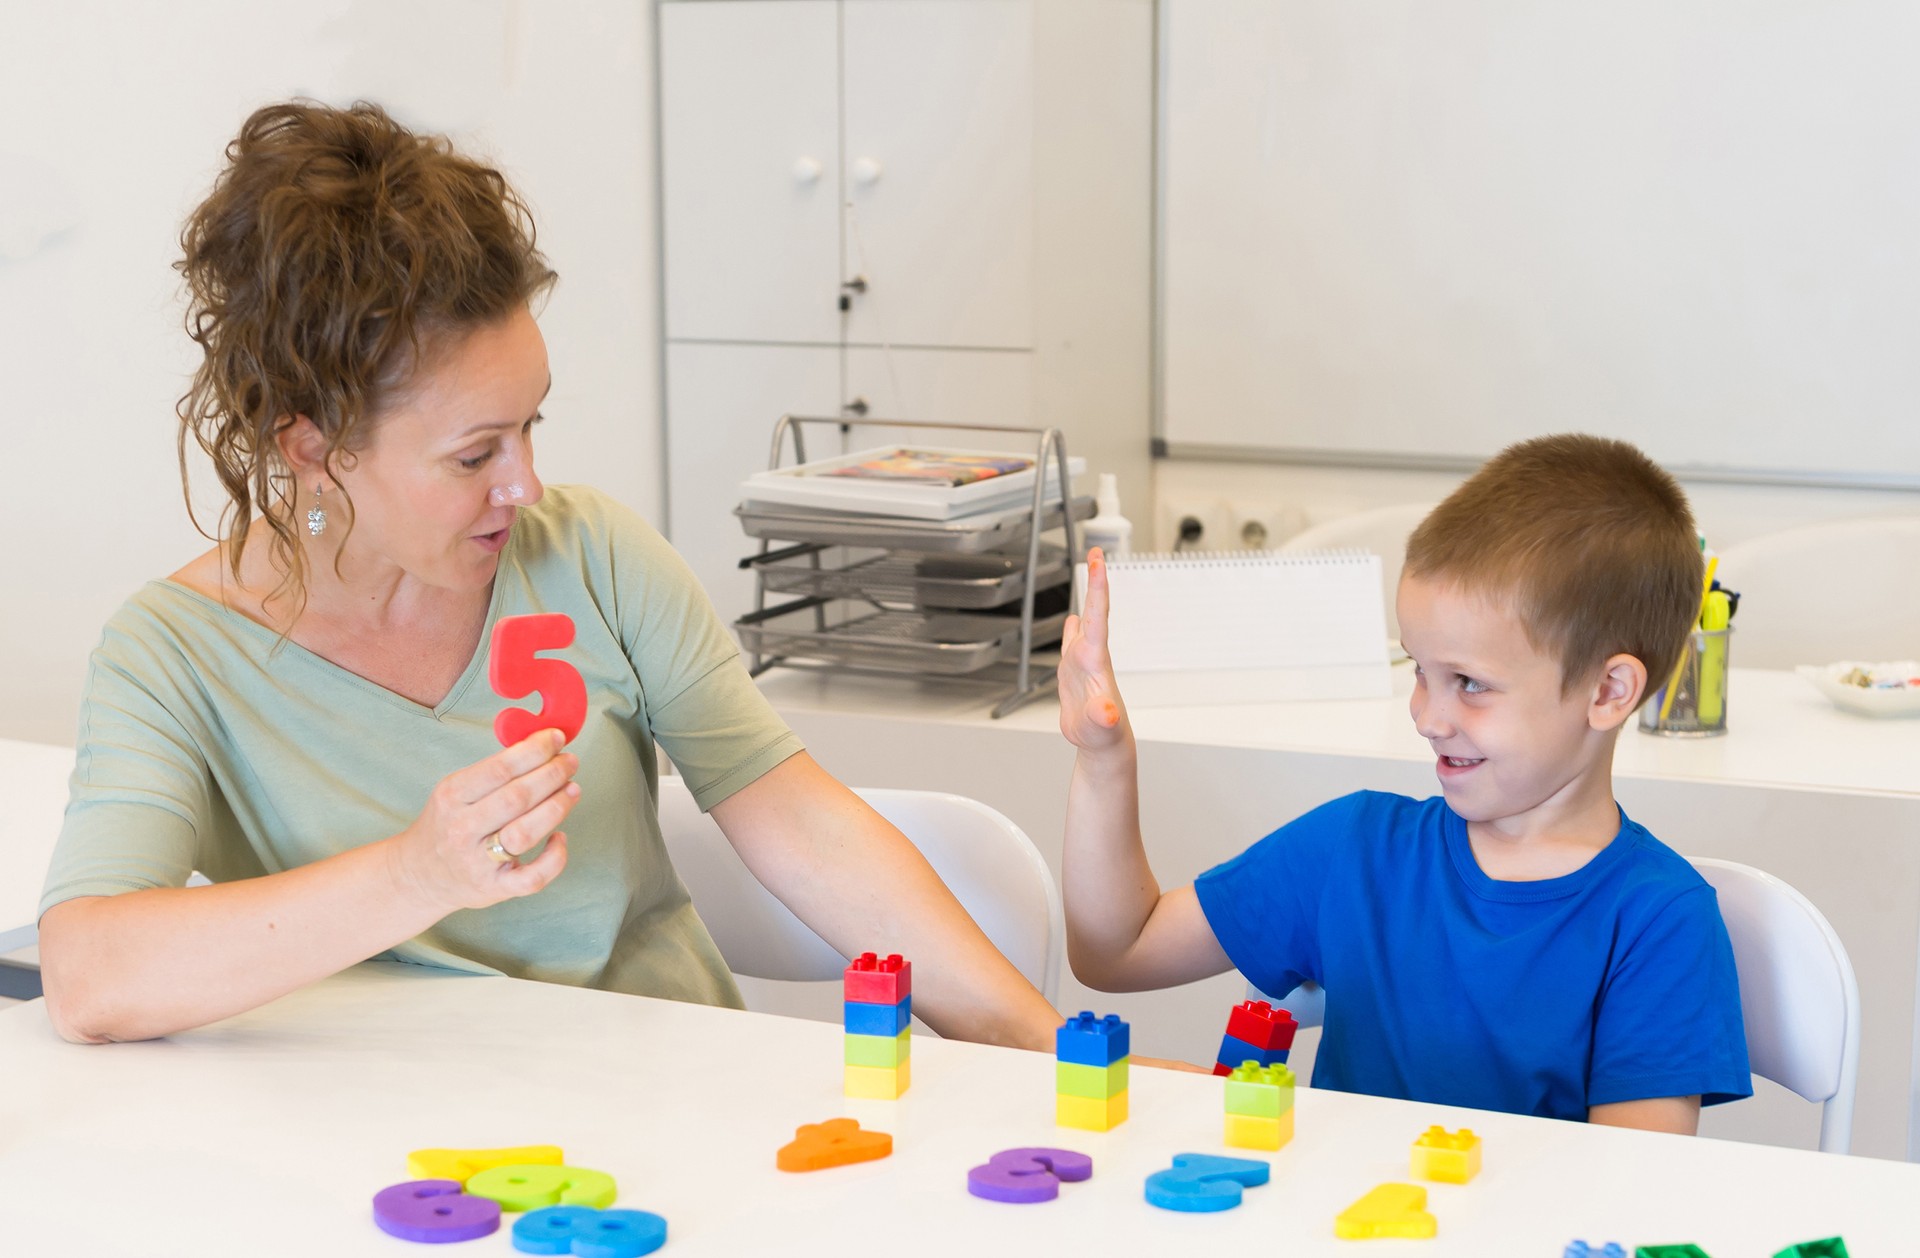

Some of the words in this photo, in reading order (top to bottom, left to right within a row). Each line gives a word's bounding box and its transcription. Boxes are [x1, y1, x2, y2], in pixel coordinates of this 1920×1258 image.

[490, 613, 588, 749] 5
[776, 1117, 894, 1174] 4
[968, 1147, 1092, 1204] 3
[1145, 1152, 1270, 1213] 2
[511, 1205, 668, 1258] 8
[1334, 1182, 1437, 1240] 1
